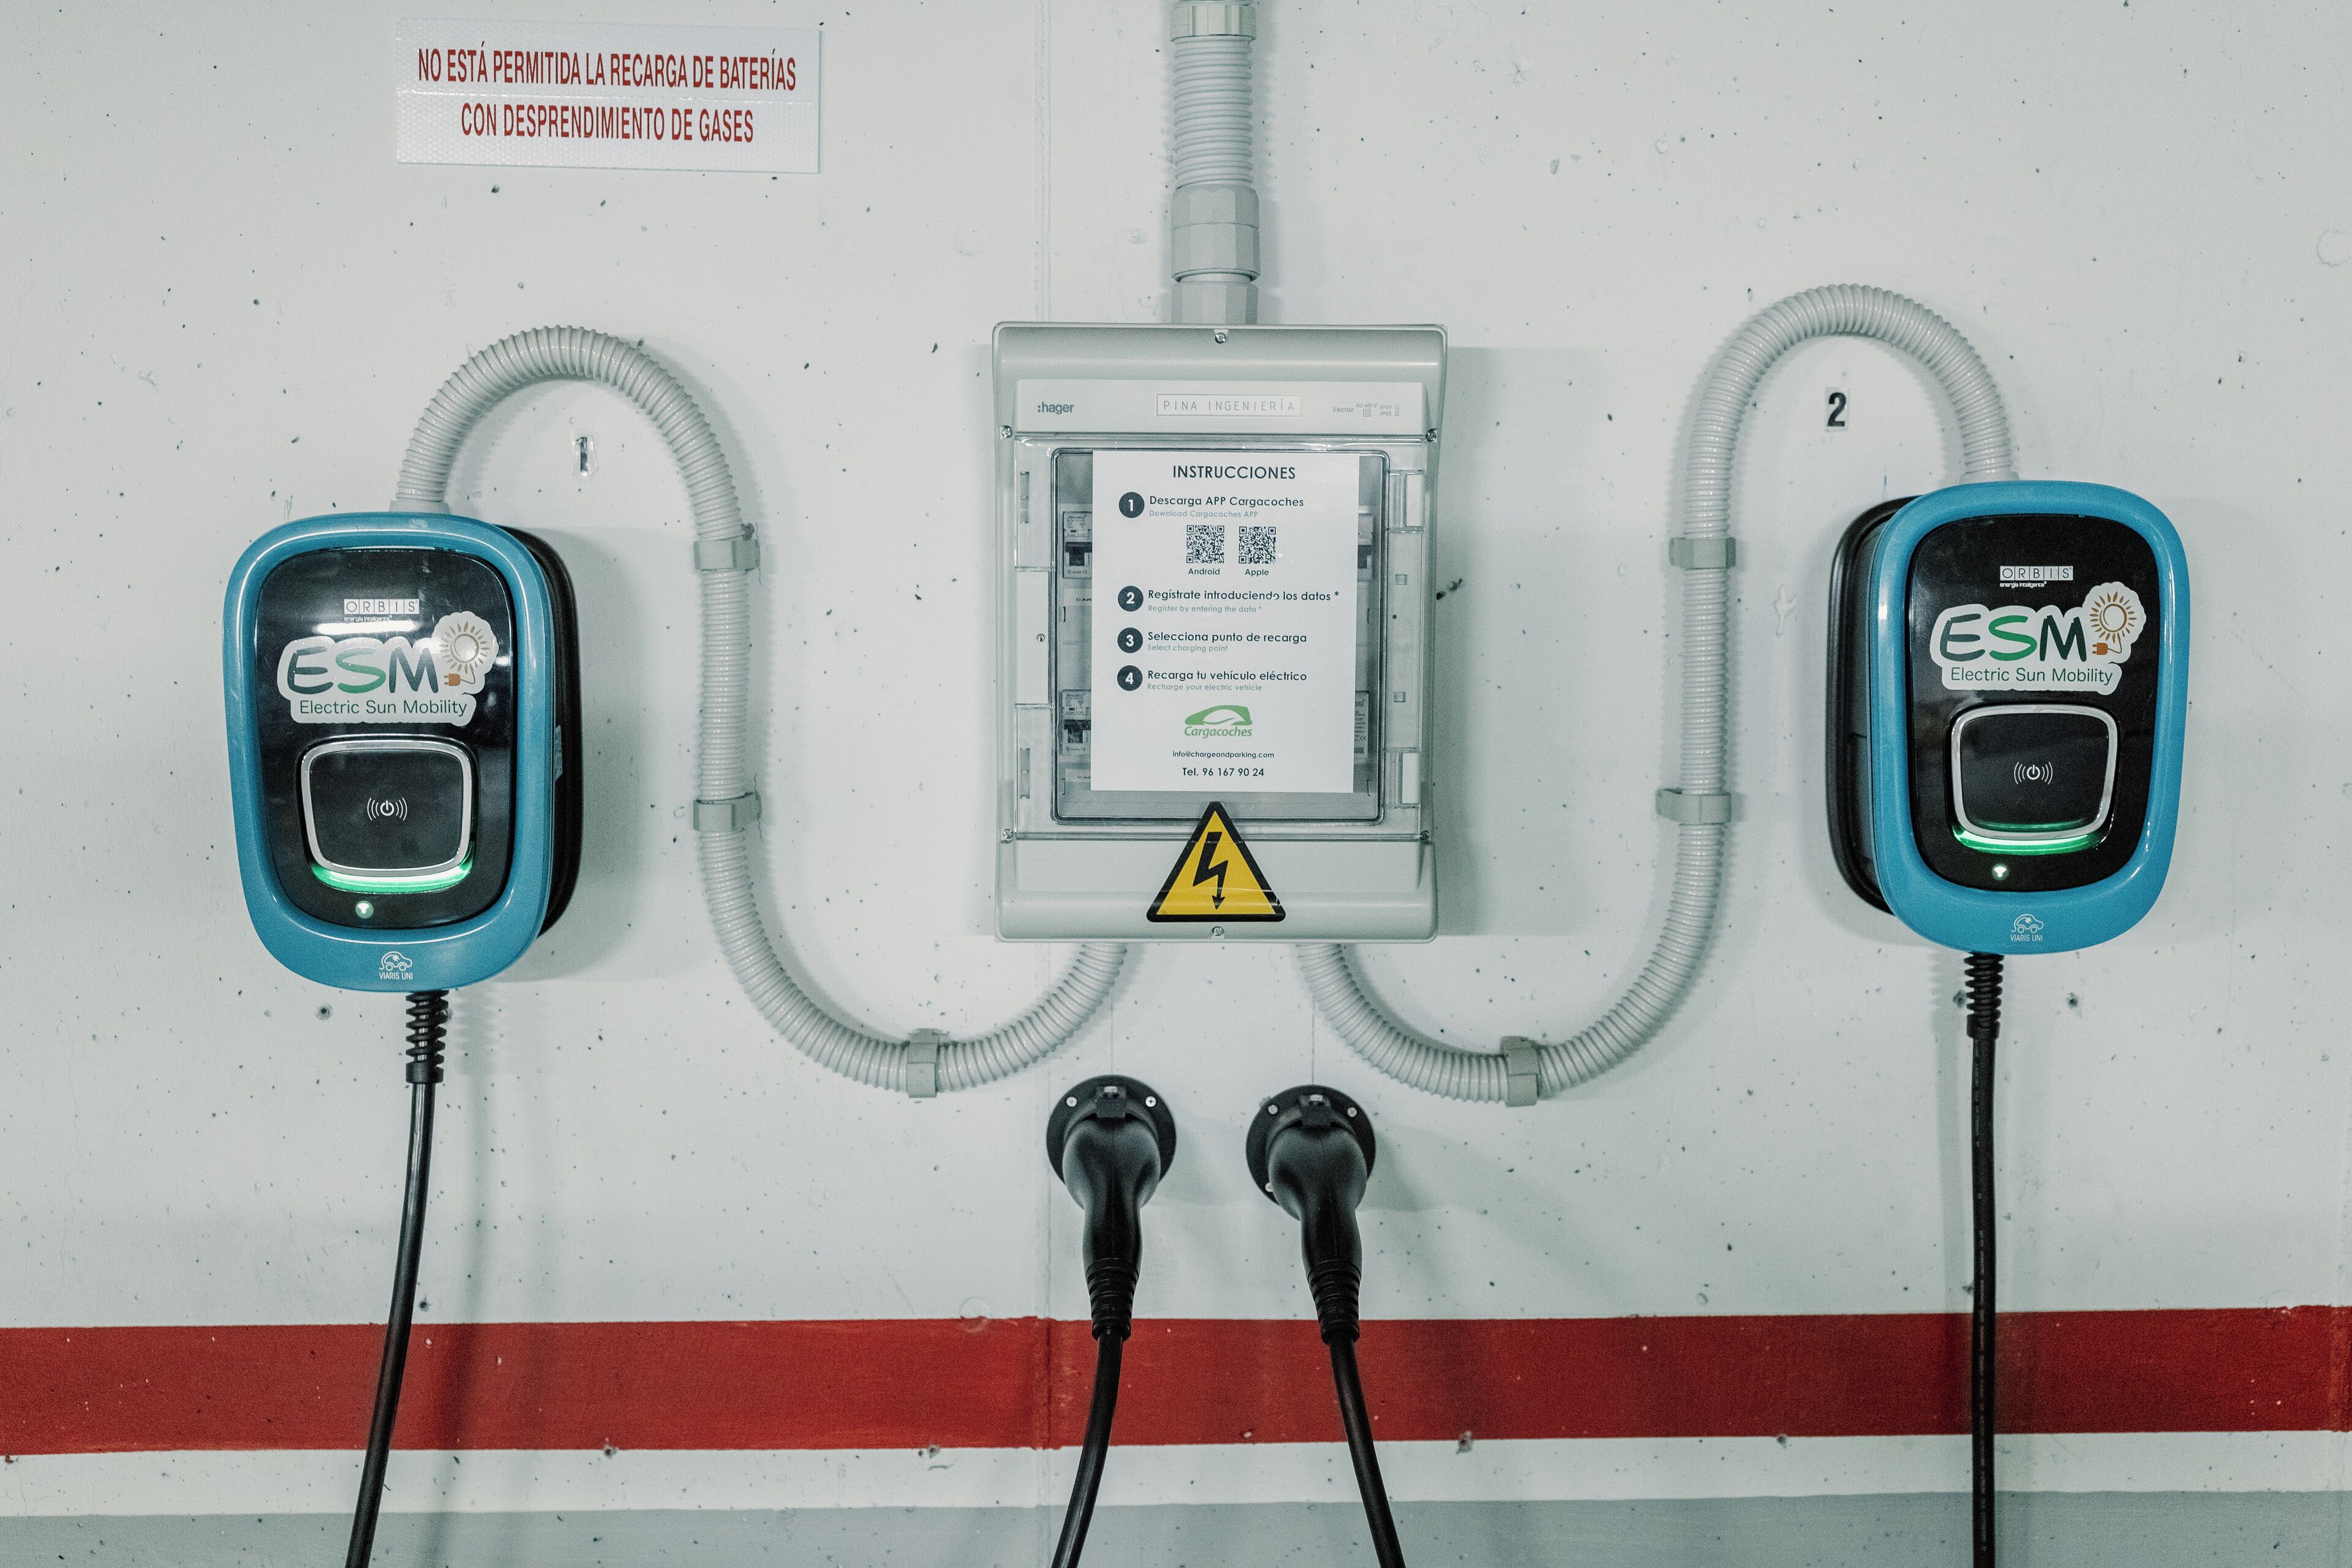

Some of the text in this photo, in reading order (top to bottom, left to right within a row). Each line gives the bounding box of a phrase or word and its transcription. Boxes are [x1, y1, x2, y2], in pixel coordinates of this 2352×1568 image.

[418, 40, 796, 91] NO ESTÁ PERMITIDA LA RECARGA DE BATERÍAS
[461, 102, 753, 143] CON DESPRENDIMIENTO DE GASES
[1164, 398, 1294, 411] PINA INGENIERÍA
[1828, 392, 1847, 427] 2
[576, 437, 588, 472] 1
[1173, 466, 1295, 480] INSTRUCCIONES
[1128, 496, 1304, 511] 1 Descarga APP Cargacoches
[1189, 510, 1242, 519] Cargacoches
[1245, 568, 1269, 577] Apple
[2002, 568, 2069, 578] ORBIS
[1126, 592, 1135, 604] 2
[1148, 589, 1201, 601] Regístrate
[1204, 590, 1280, 600] introduciendo
[1283, 591, 1298, 600] los
[1301, 591, 1331, 601] datos
[347, 601, 415, 612] ORBIS
[1148, 605, 1178, 613] Register
[1191, 605, 1223, 614] entering
[1126, 631, 1307, 647] 3 Selecciona punto de recarga
[1940, 613, 2087, 662] ESM
[1172, 644, 1207, 653] charging
[1208, 644, 1228, 653] point
[287, 647, 439, 694] ESM
[1125, 670, 1307, 685] 4 Recarga tu vehículo eléctrico
[1951, 667, 2113, 686] Electric Sun Mobility
[1147, 683, 1184, 692] Recharge
[300, 699, 467, 717] Electric Sun Mobility
[1184, 726, 1253, 739] Cargacoches
[1172, 750, 1275, 760] info@chargeandparking.com
[1182, 767, 1264, 777] Tel. 96 167 90 24
